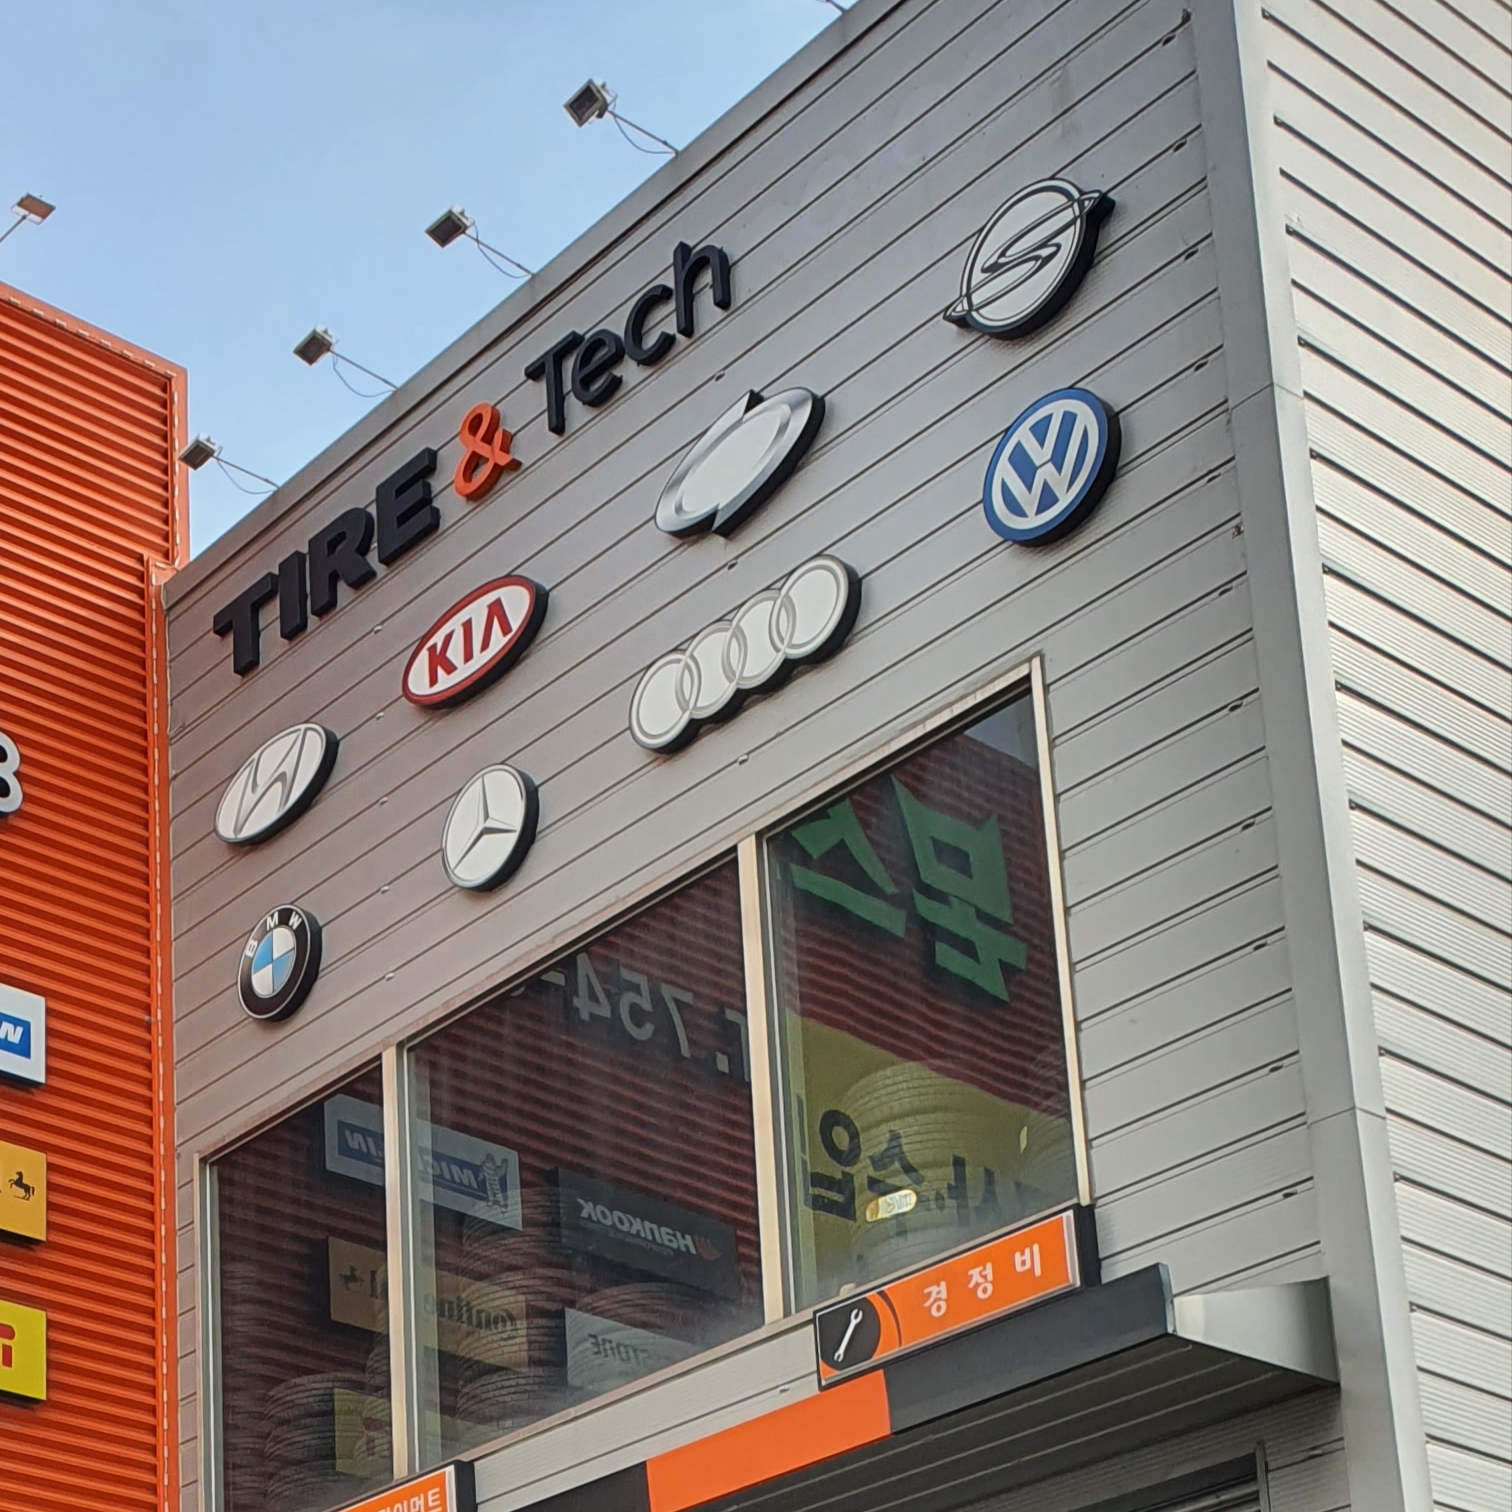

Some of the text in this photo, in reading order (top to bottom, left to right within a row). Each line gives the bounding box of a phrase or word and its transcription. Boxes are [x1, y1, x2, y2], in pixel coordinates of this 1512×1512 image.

[213, 241, 734, 677] TIRE & Tech
[424, 595, 517, 690] KIA
[245, 910, 303, 959] BMW
